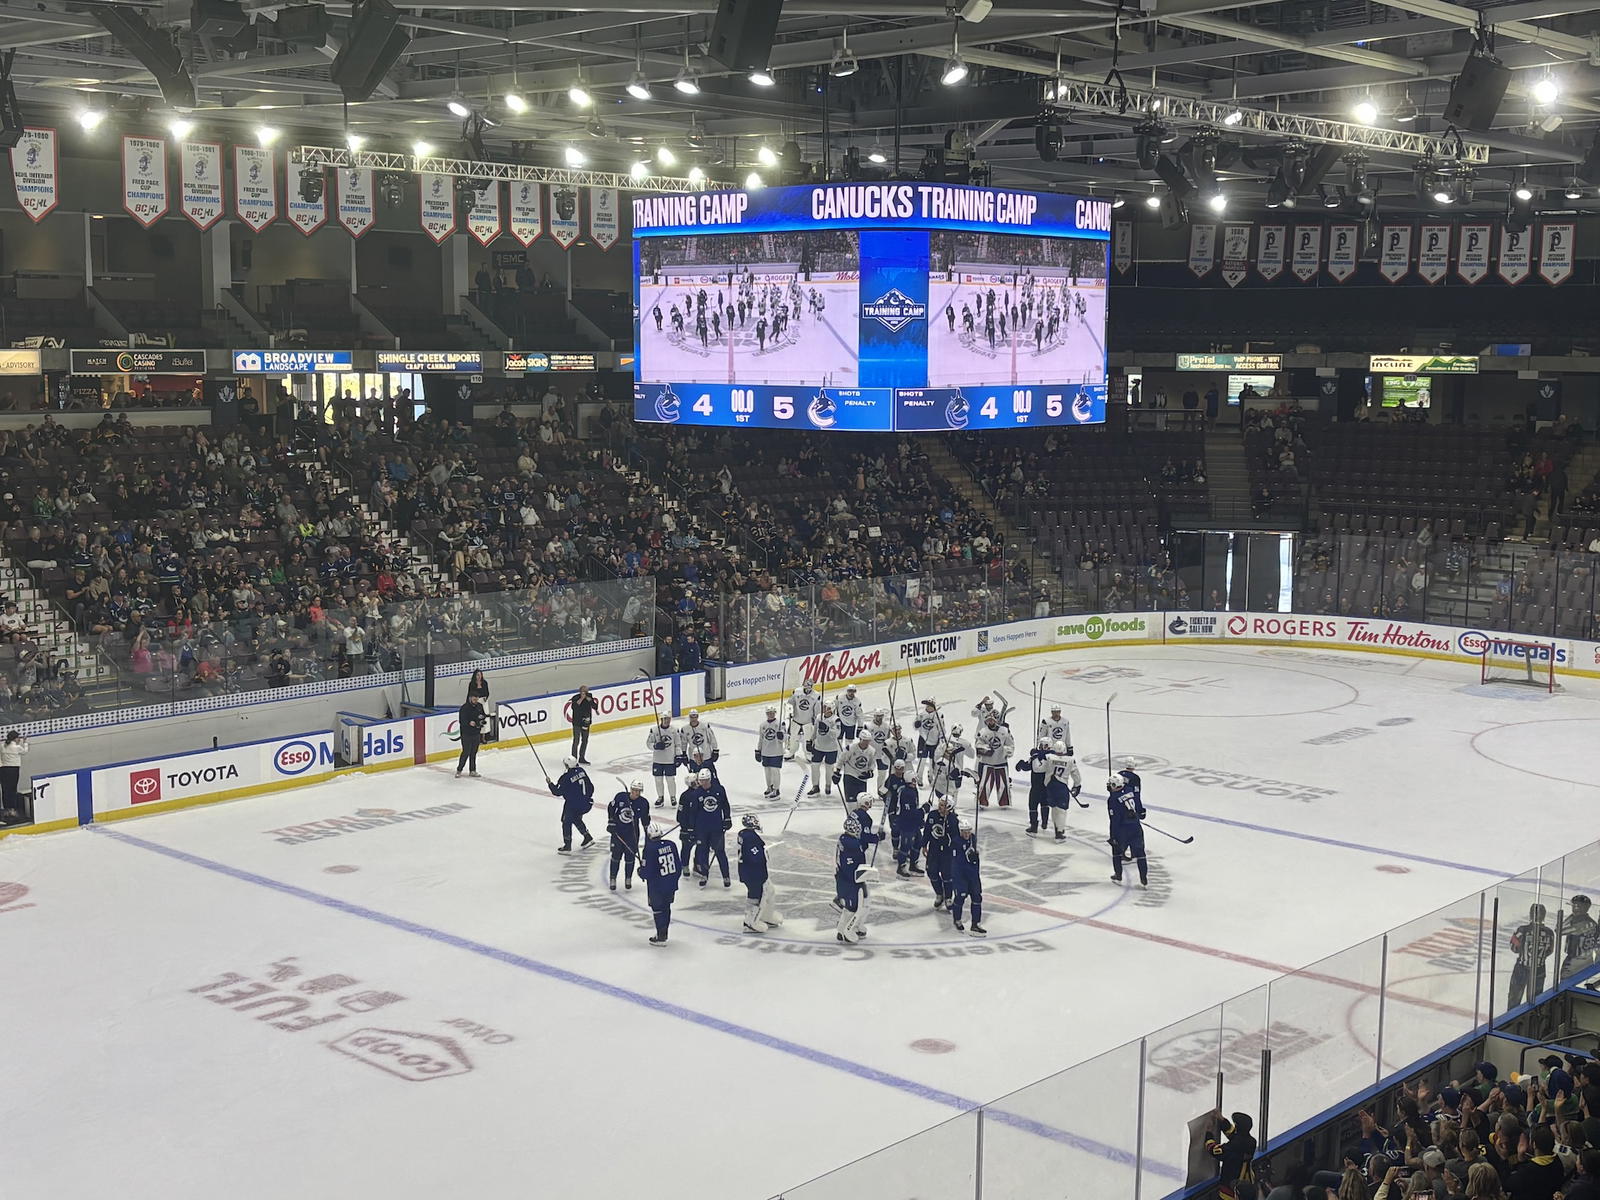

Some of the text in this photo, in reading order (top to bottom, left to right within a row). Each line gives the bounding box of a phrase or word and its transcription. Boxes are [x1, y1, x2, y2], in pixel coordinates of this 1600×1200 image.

[17, 185, 54, 194] CHAMPIONS
[127, 192, 164, 200] CHAMPIONS
[184, 196, 220, 204] CHAMPIONS
[24, 198, 48, 210] BCHL
[134, 204, 158, 216] BCHL
[290, 202, 323, 210] CHAMPIONS
[812, 186, 1037, 225] CANUCKS TRAINING CAMP
[191, 208, 215, 219] BCHL
[246, 211, 268, 222] BCHL
[423, 211, 452, 219] CHAMPIONS
[632, 193, 748, 228] TRAINING CAMP
[296, 214, 318, 225] BCHL
[346, 217, 366, 228] BCHL
[428, 222, 447, 234] BCHL
[474, 226, 493, 236] BCHL
[518, 228, 535, 238] BCHL
[556, 230, 574, 240] BCHL
[596, 232, 613, 243] BCHL
[864, 307, 924, 316] TRAINING CAMP
[264, 352, 334, 364] BROADVIEW
[378, 354, 480, 363] SHINGLE CREEK IMPORTS
[527, 358, 548, 368] SIGNS
[692, 394, 713, 416] 4
[773, 396, 794, 420] 5
[980, 396, 998, 420] 4
[1046, 394, 1063, 417] 5
[1016, 415, 1028, 423] 1ST
[1058, 618, 1146, 636] save on foods
[1190, 617, 1210, 625] TICKETS
[1253, 618, 1336, 638] ROGERS
[1347, 622, 1450, 652] Tim Hortons
[1463, 636, 1486, 648] Esso
[900, 636, 956, 659] PENTICTON
[800, 650, 881, 684] Molson
[742, 676, 766, 686] Happen
[281, 750, 310, 766] Esso
[167, 764, 239, 788] TOYOTA
[578, 778, 586, 796] 7
[1154, 769, 1322, 802] LIQUOR
[1263, 778, 1339, 796] OTTER
[262, 815, 365, 837] TOTAL
[274, 802, 472, 846] RESTORATION
[658, 845, 672, 854] WHITE
[658, 852, 676, 876] 38
[715, 936, 1055, 961] Events Centre
[188, 971, 348, 1033] FUEL
[440, 1017, 516, 1044] Otter
